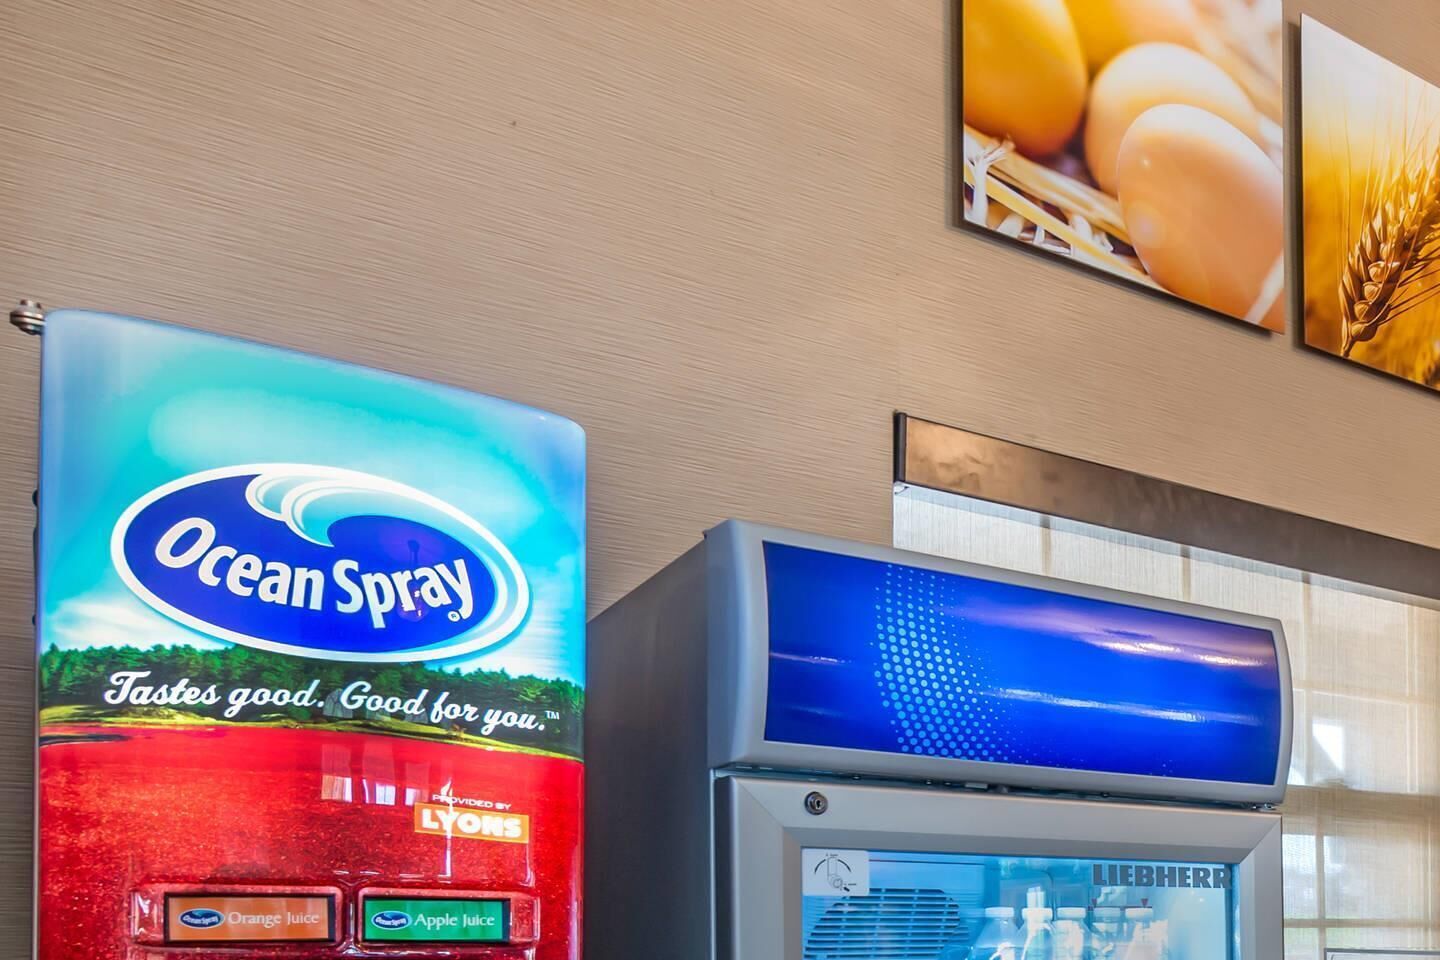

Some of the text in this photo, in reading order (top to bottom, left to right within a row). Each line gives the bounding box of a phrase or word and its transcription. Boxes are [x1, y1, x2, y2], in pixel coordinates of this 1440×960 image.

[155, 517, 325, 611] Ocean
[104, 670, 221, 706] Tastes
[224, 678, 325, 718] good.
[339, 680, 428, 716] Good
[429, 691, 479, 723] for
[432, 794, 511, 810] PROVIDED BY
[422, 808, 522, 838] LYONS
[1093, 864, 1231, 888] LIEBHERR
[228, 911, 320, 928] Orange Juice
[414, 913, 495, 930] Apple Juice
